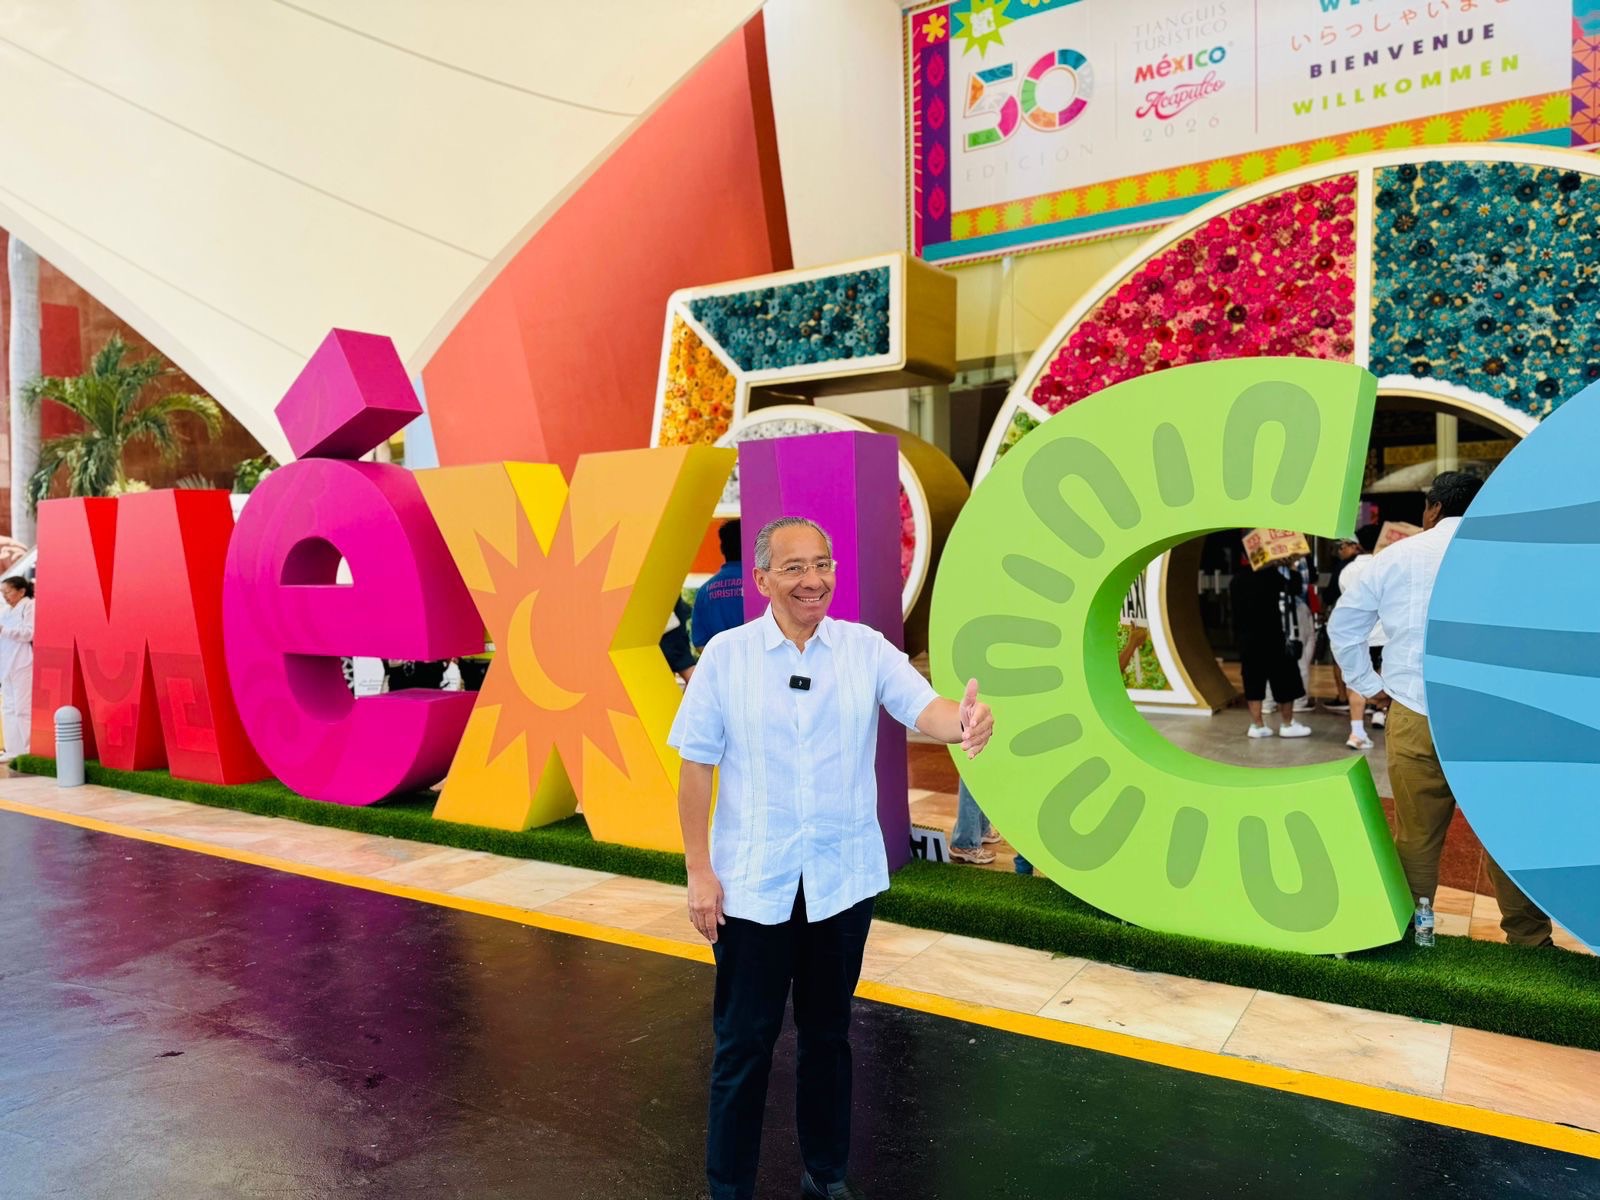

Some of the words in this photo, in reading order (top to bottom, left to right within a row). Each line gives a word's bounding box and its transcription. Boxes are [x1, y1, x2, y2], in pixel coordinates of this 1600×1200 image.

[1132, 1, 1228, 38] TIANGUIS
[1132, 18, 1229, 54] TURÍSTICO
[1309, 23, 1496, 79] BIENVENUE
[962, 47, 1095, 153] 50
[1135, 69, 1227, 121] Acapulco
[1292, 54, 1520, 117] WILLKOMMEN
[965, 142, 1096, 183] EDICIÓN
[706, 578, 743, 592] FACILITAD
[709, 587, 744, 601] TURÍSTIC
